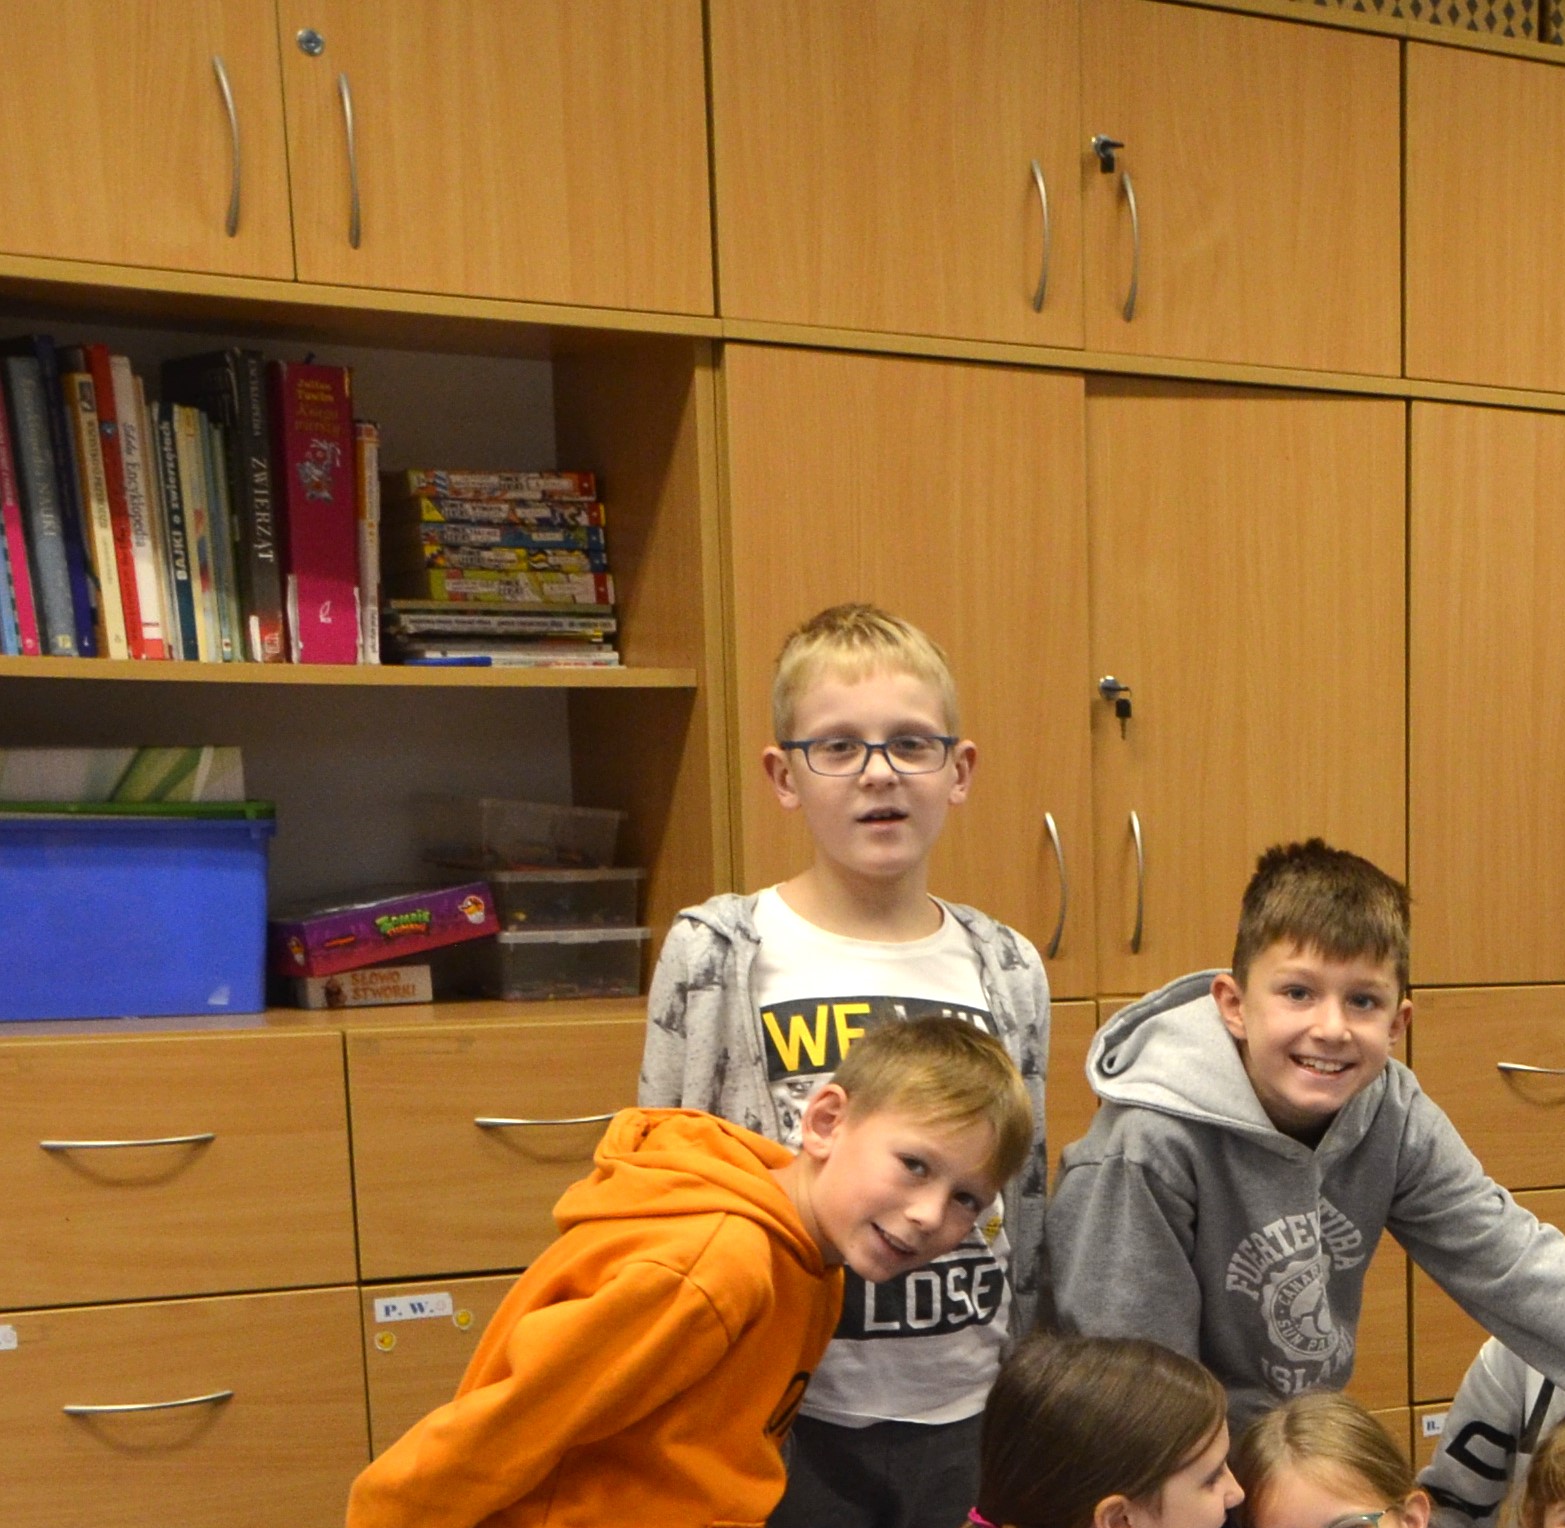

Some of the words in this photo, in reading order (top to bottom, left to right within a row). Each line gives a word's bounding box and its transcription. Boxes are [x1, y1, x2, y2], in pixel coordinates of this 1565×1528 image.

[124, 460, 147, 548] Encyklopedia
[251, 456, 274, 563] ZWIERZĄT
[172, 530, 189, 581] BAJKI
[863, 1261, 999, 1333] LOSE
